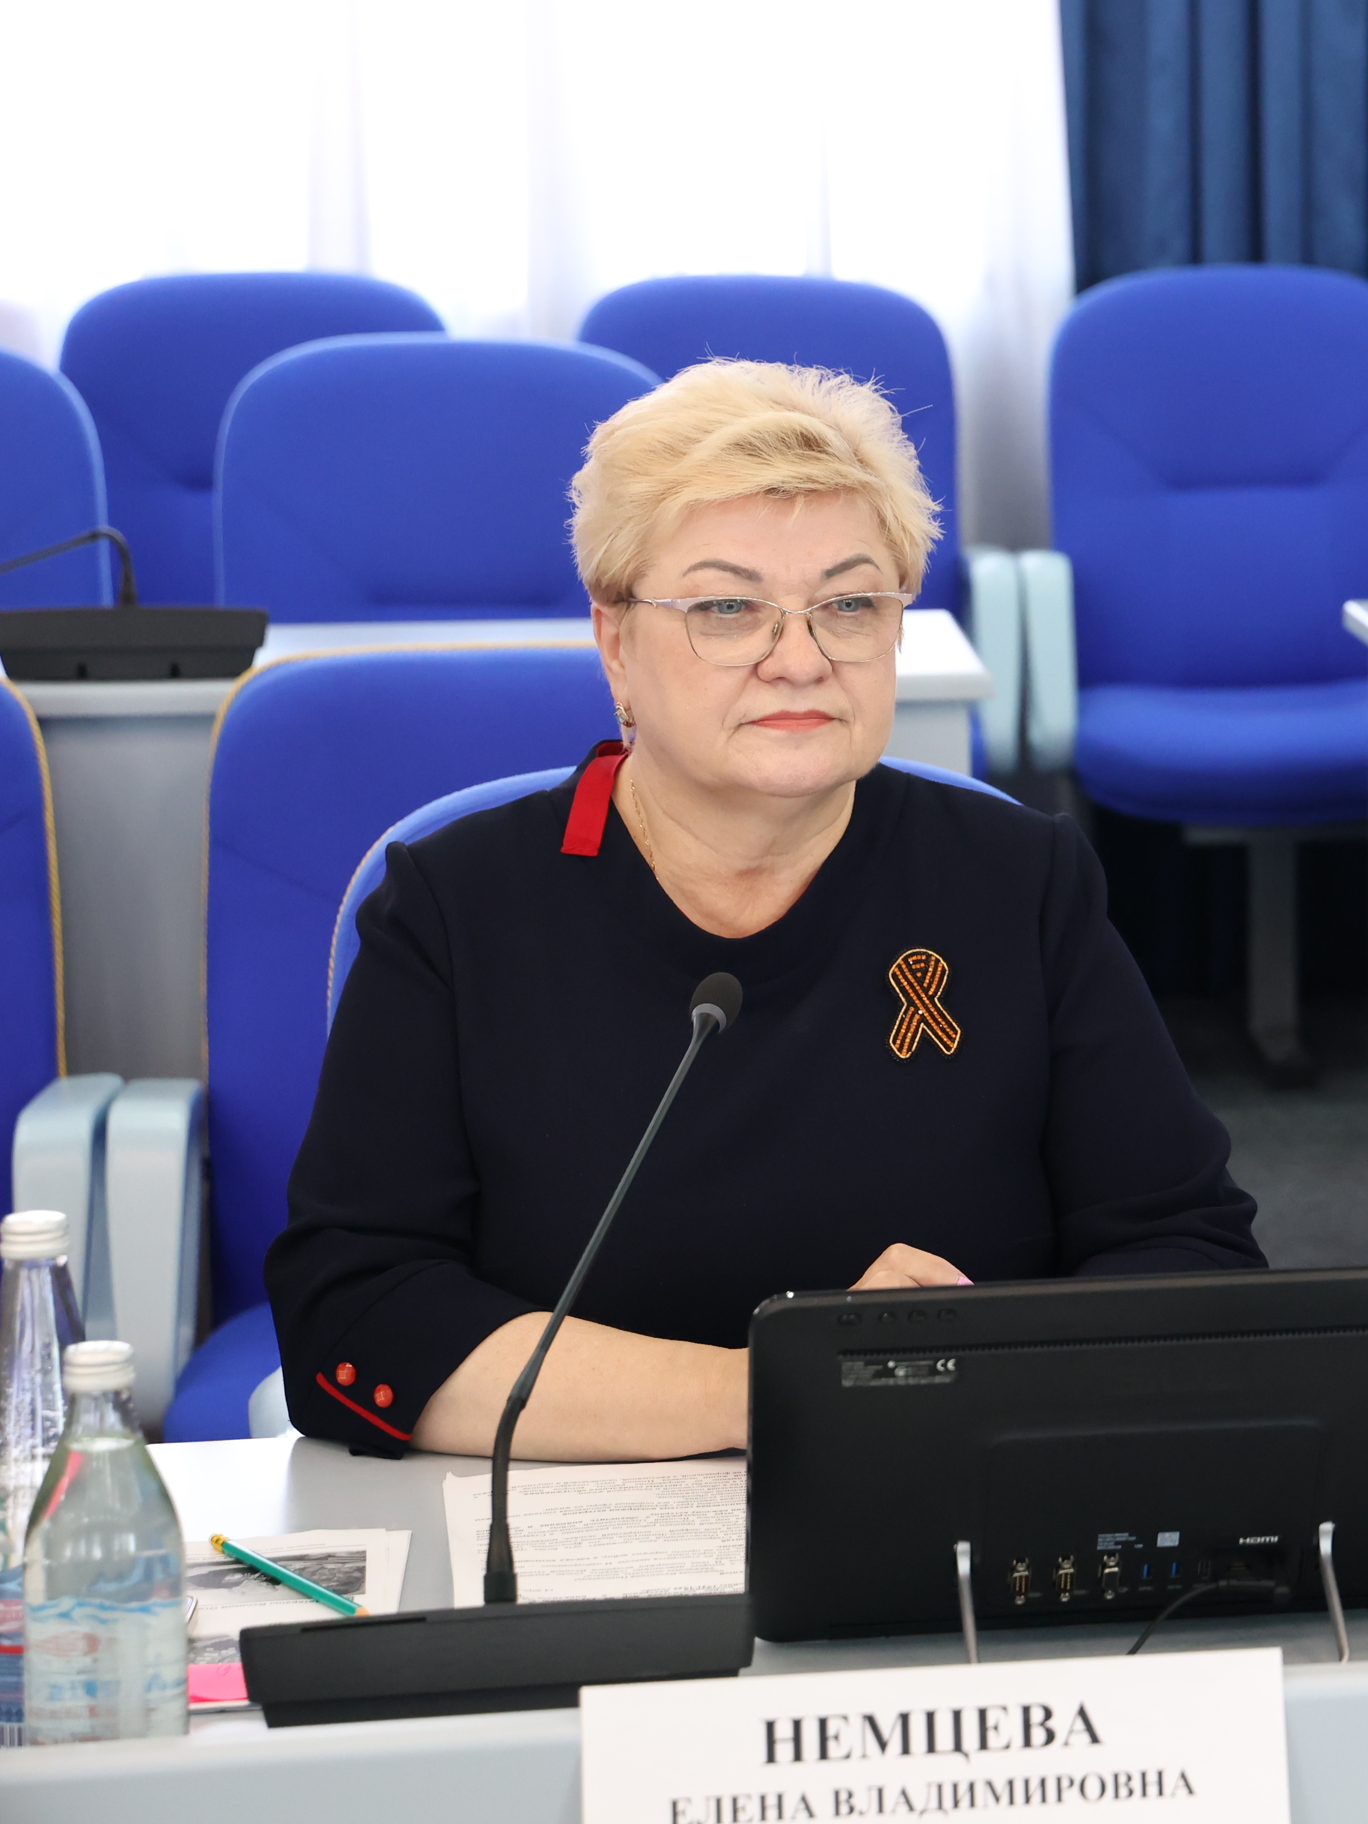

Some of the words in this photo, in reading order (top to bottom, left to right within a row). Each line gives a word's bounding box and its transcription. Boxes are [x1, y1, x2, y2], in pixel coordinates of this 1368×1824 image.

[1238, 1535, 1279, 1545] HDMI
[761, 1700, 1103, 1766] НЕМЦЕВА
[669, 1790, 816, 1824] ЕЛЕНА
[832, 1768, 1197, 1817] ВЛАДИМИРОВНА
